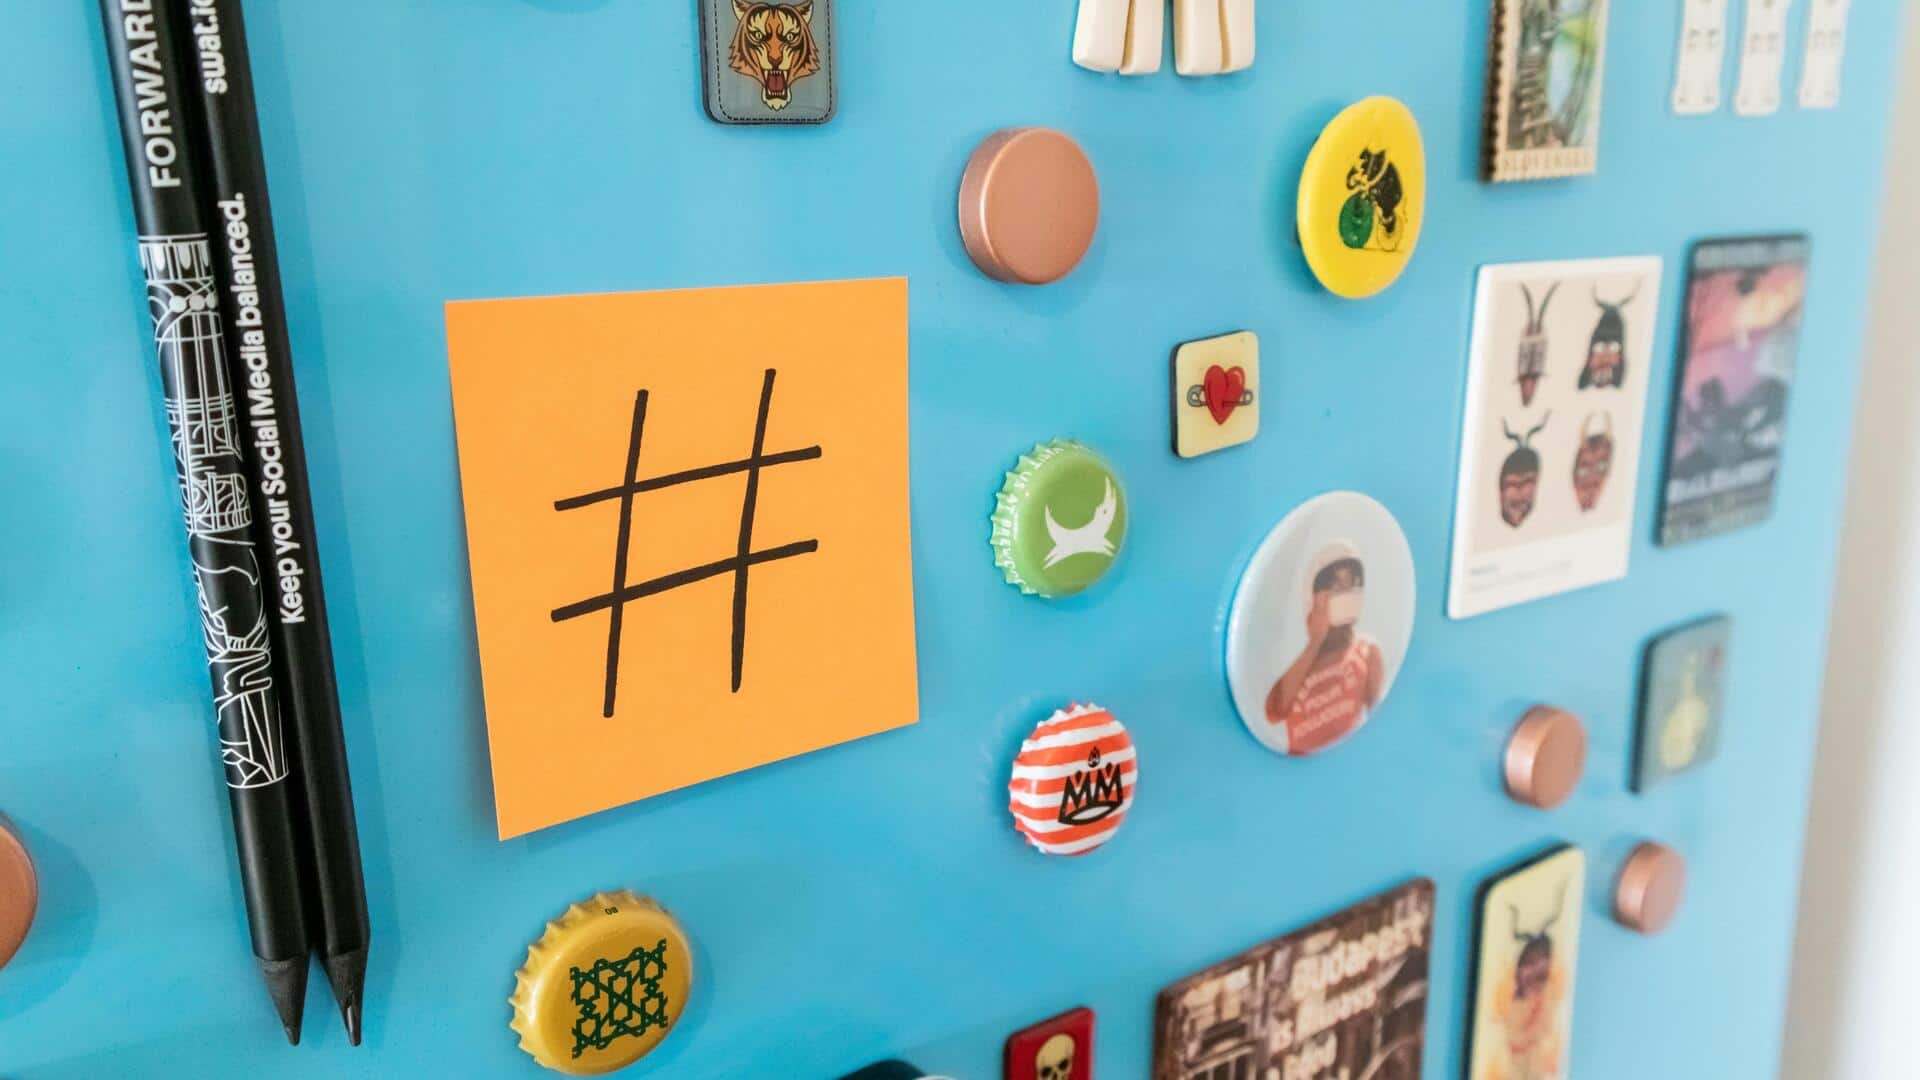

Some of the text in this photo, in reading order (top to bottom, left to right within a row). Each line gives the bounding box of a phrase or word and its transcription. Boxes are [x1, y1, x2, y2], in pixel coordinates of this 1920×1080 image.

[217, 192, 305, 624] Keep your Social Media balanced.
